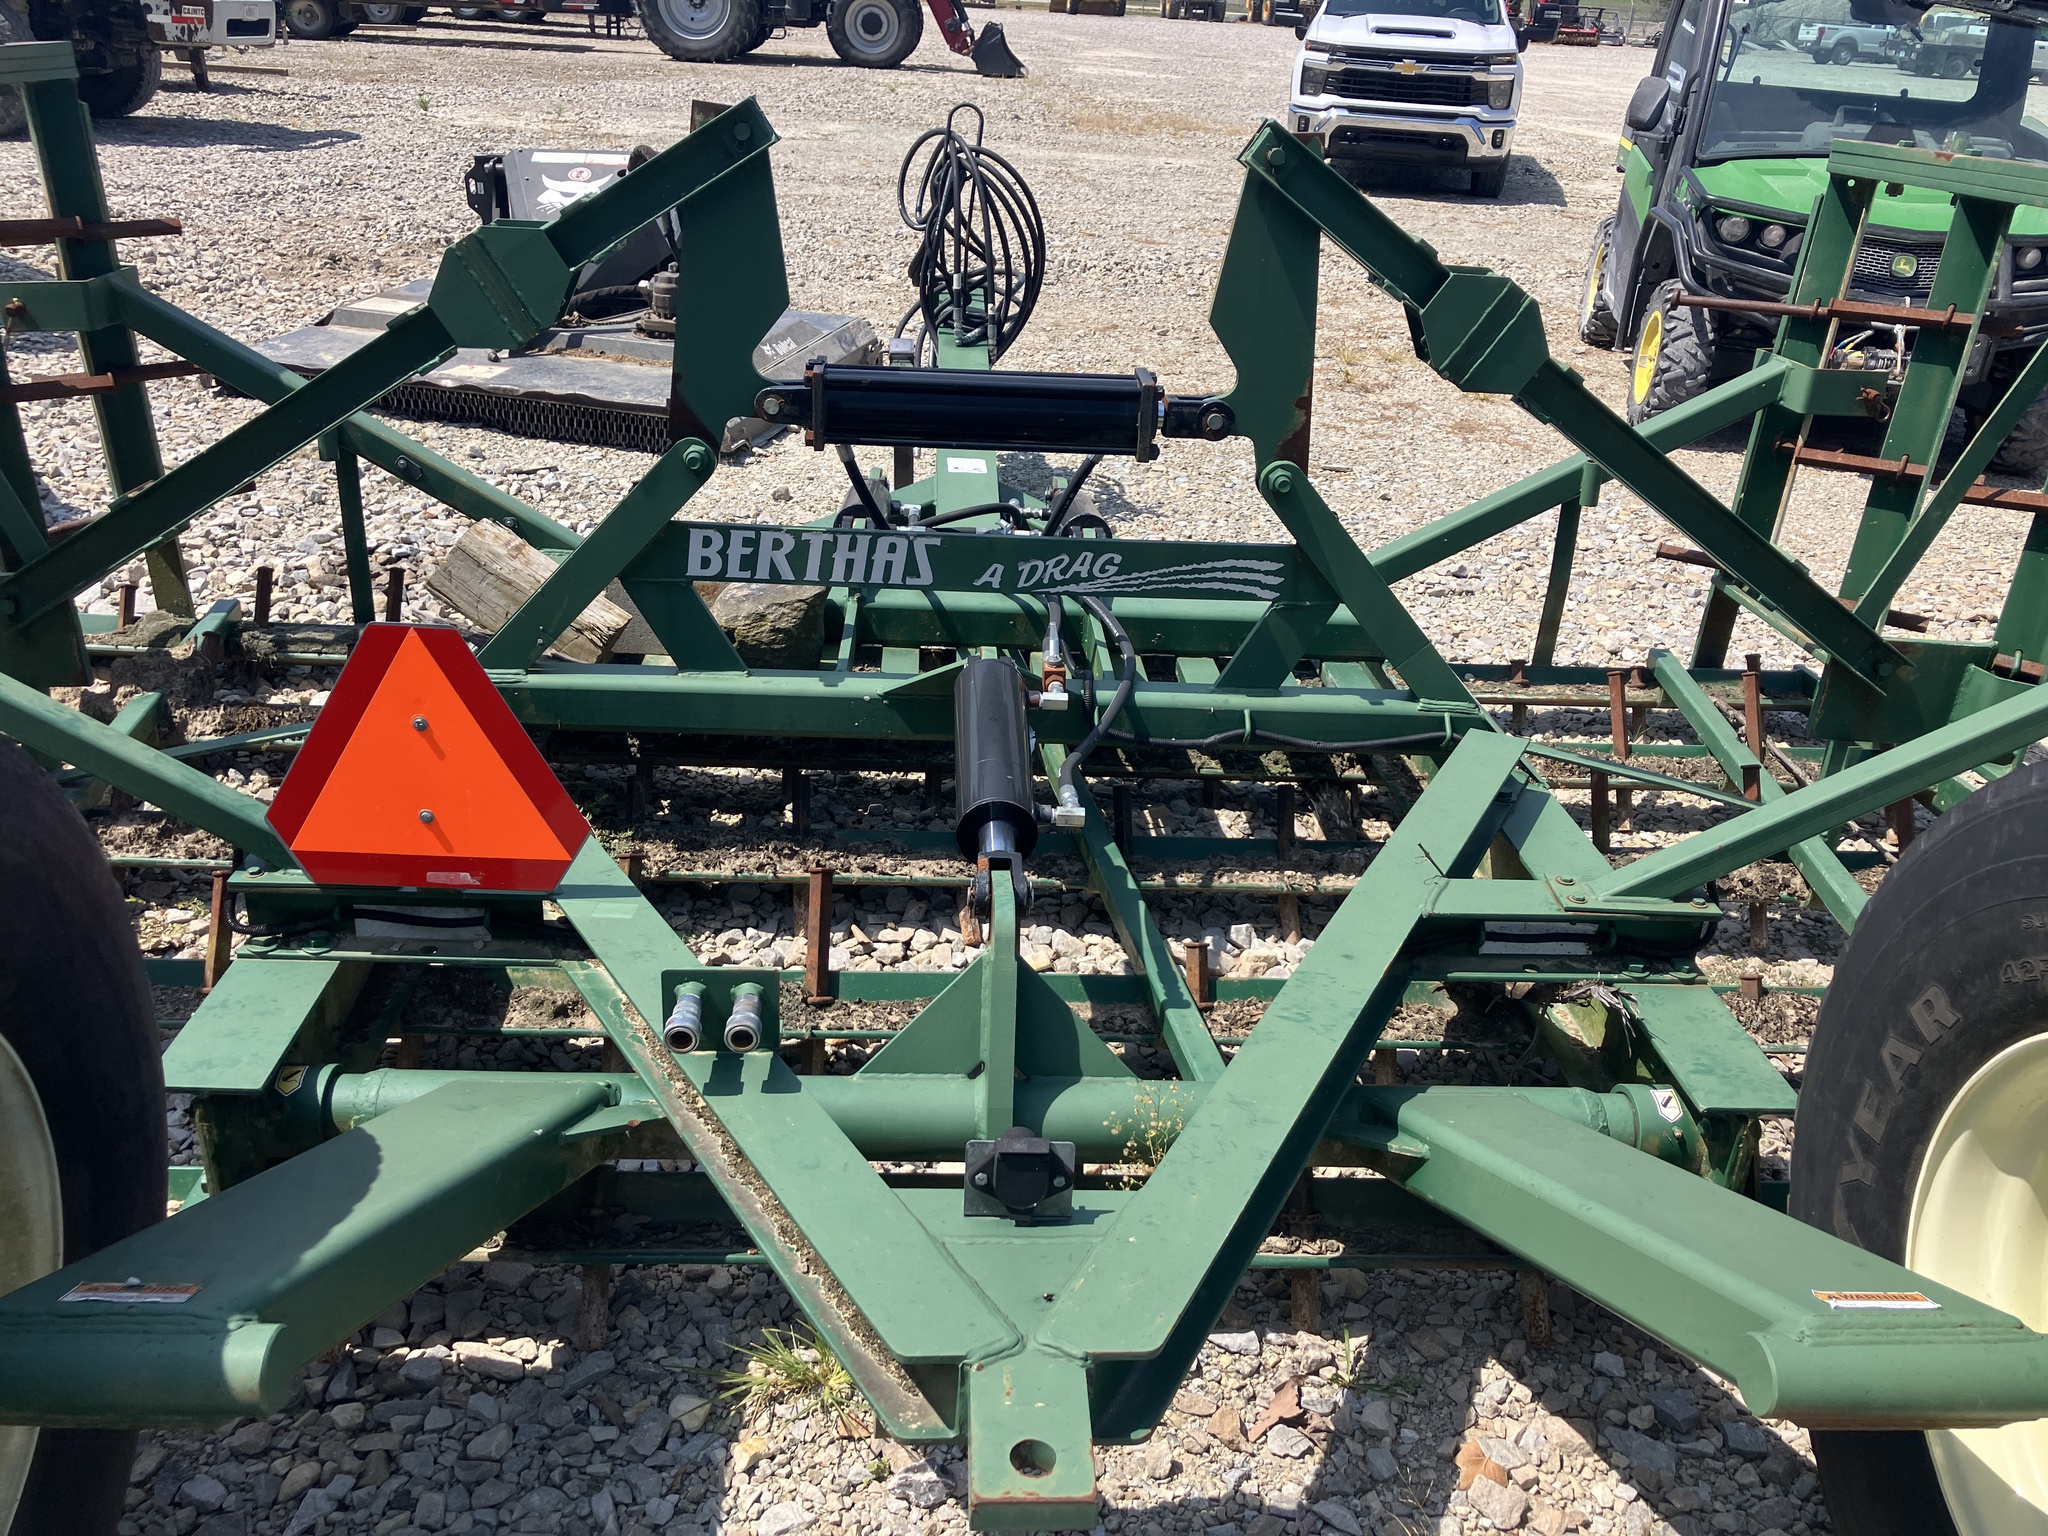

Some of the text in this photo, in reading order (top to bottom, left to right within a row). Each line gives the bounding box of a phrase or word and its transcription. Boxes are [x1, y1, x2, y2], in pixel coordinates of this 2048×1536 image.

[973, 551, 1124, 589] A DRAG
[1834, 982, 1962, 1247] YEAR
